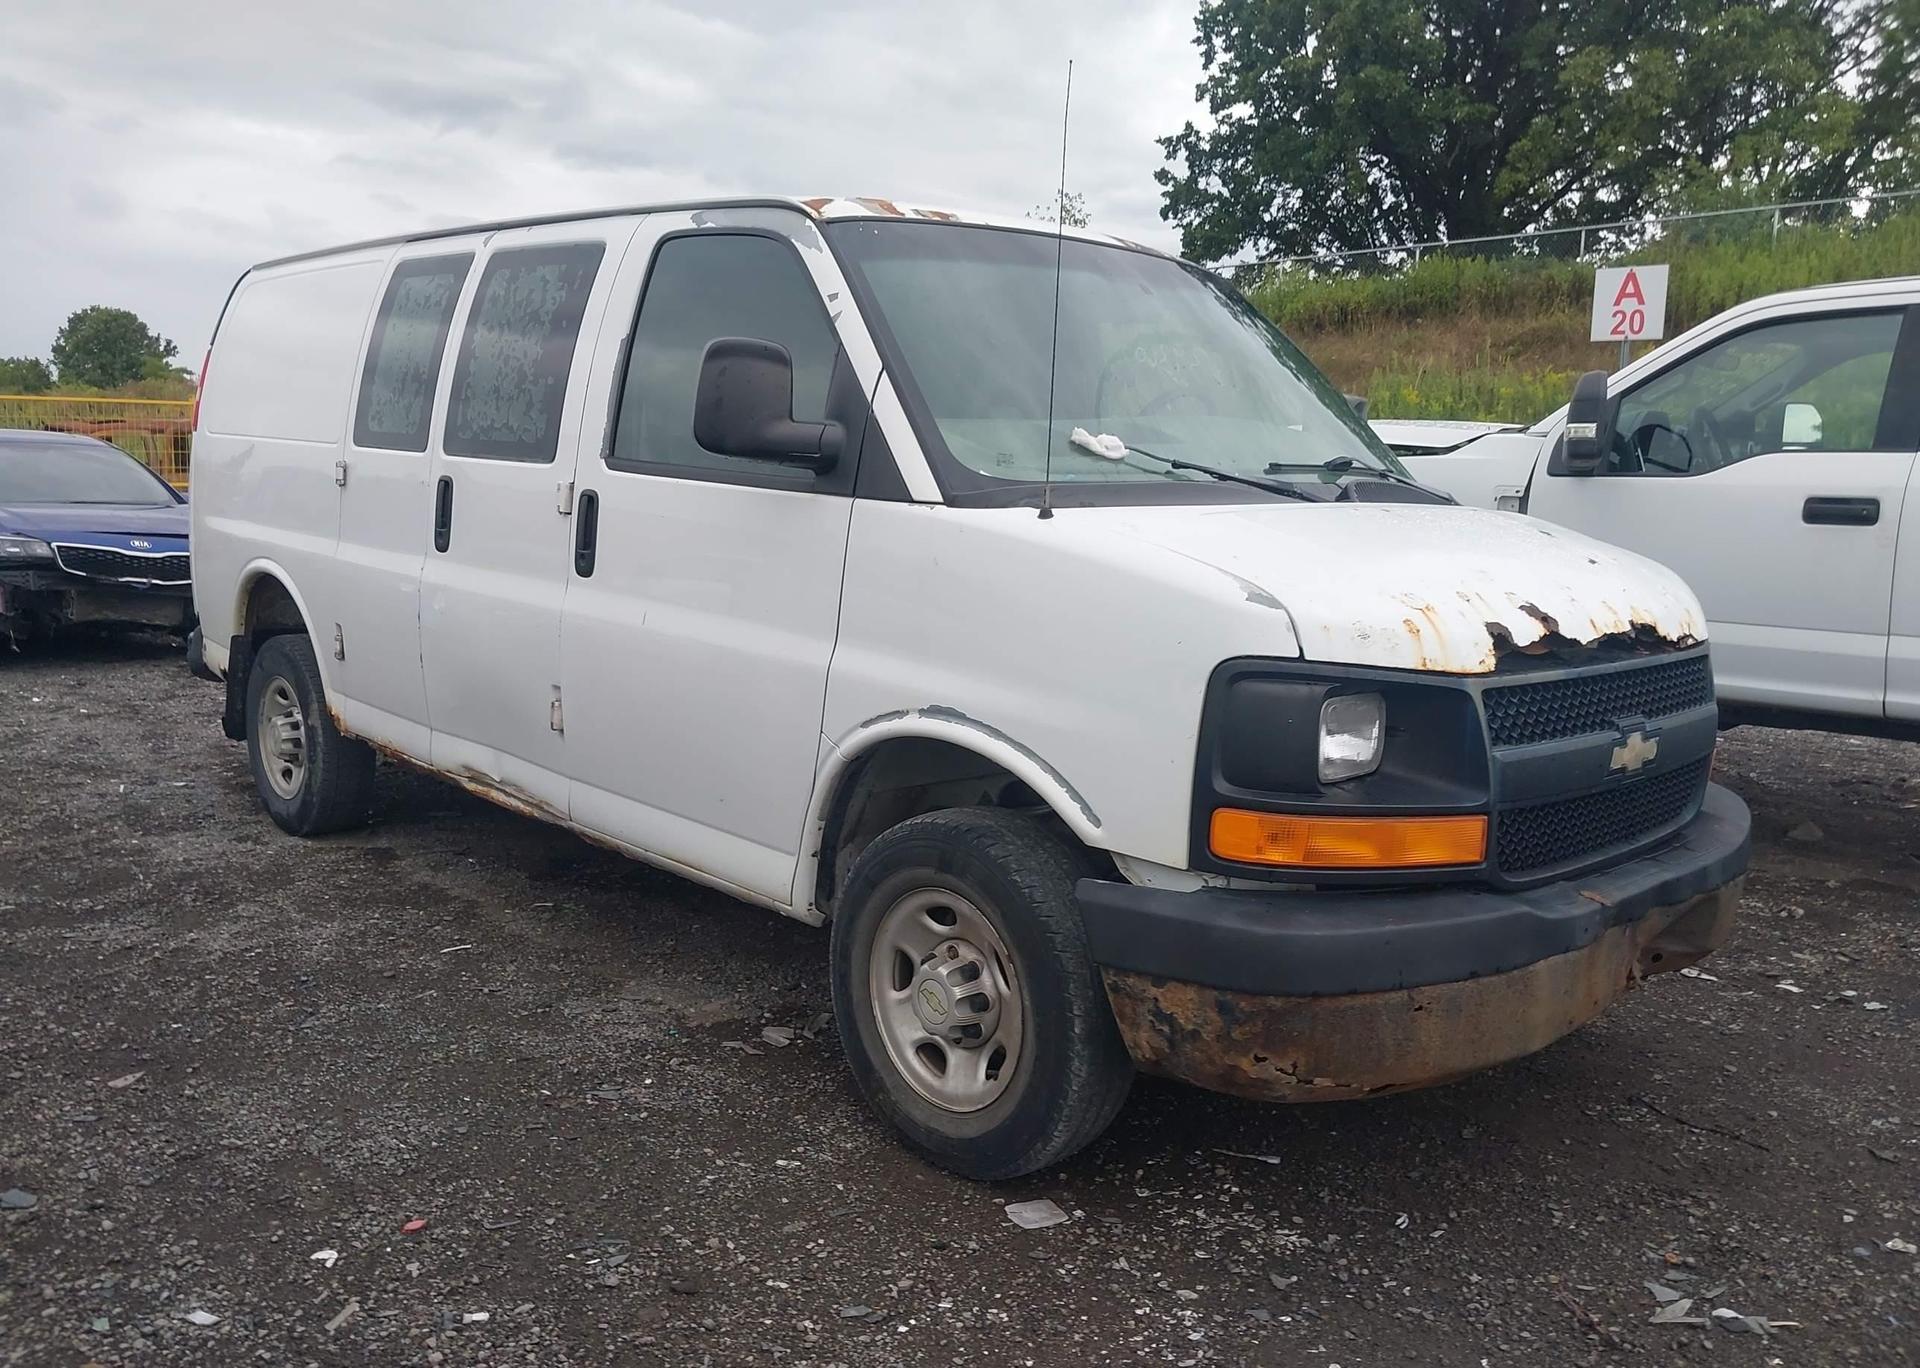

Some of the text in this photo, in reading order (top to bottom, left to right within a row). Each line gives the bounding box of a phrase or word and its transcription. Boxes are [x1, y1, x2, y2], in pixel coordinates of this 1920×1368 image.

[1613, 271, 1645, 306] A
[1611, 309, 1645, 335] 20
[131, 539, 152, 548] KIA
